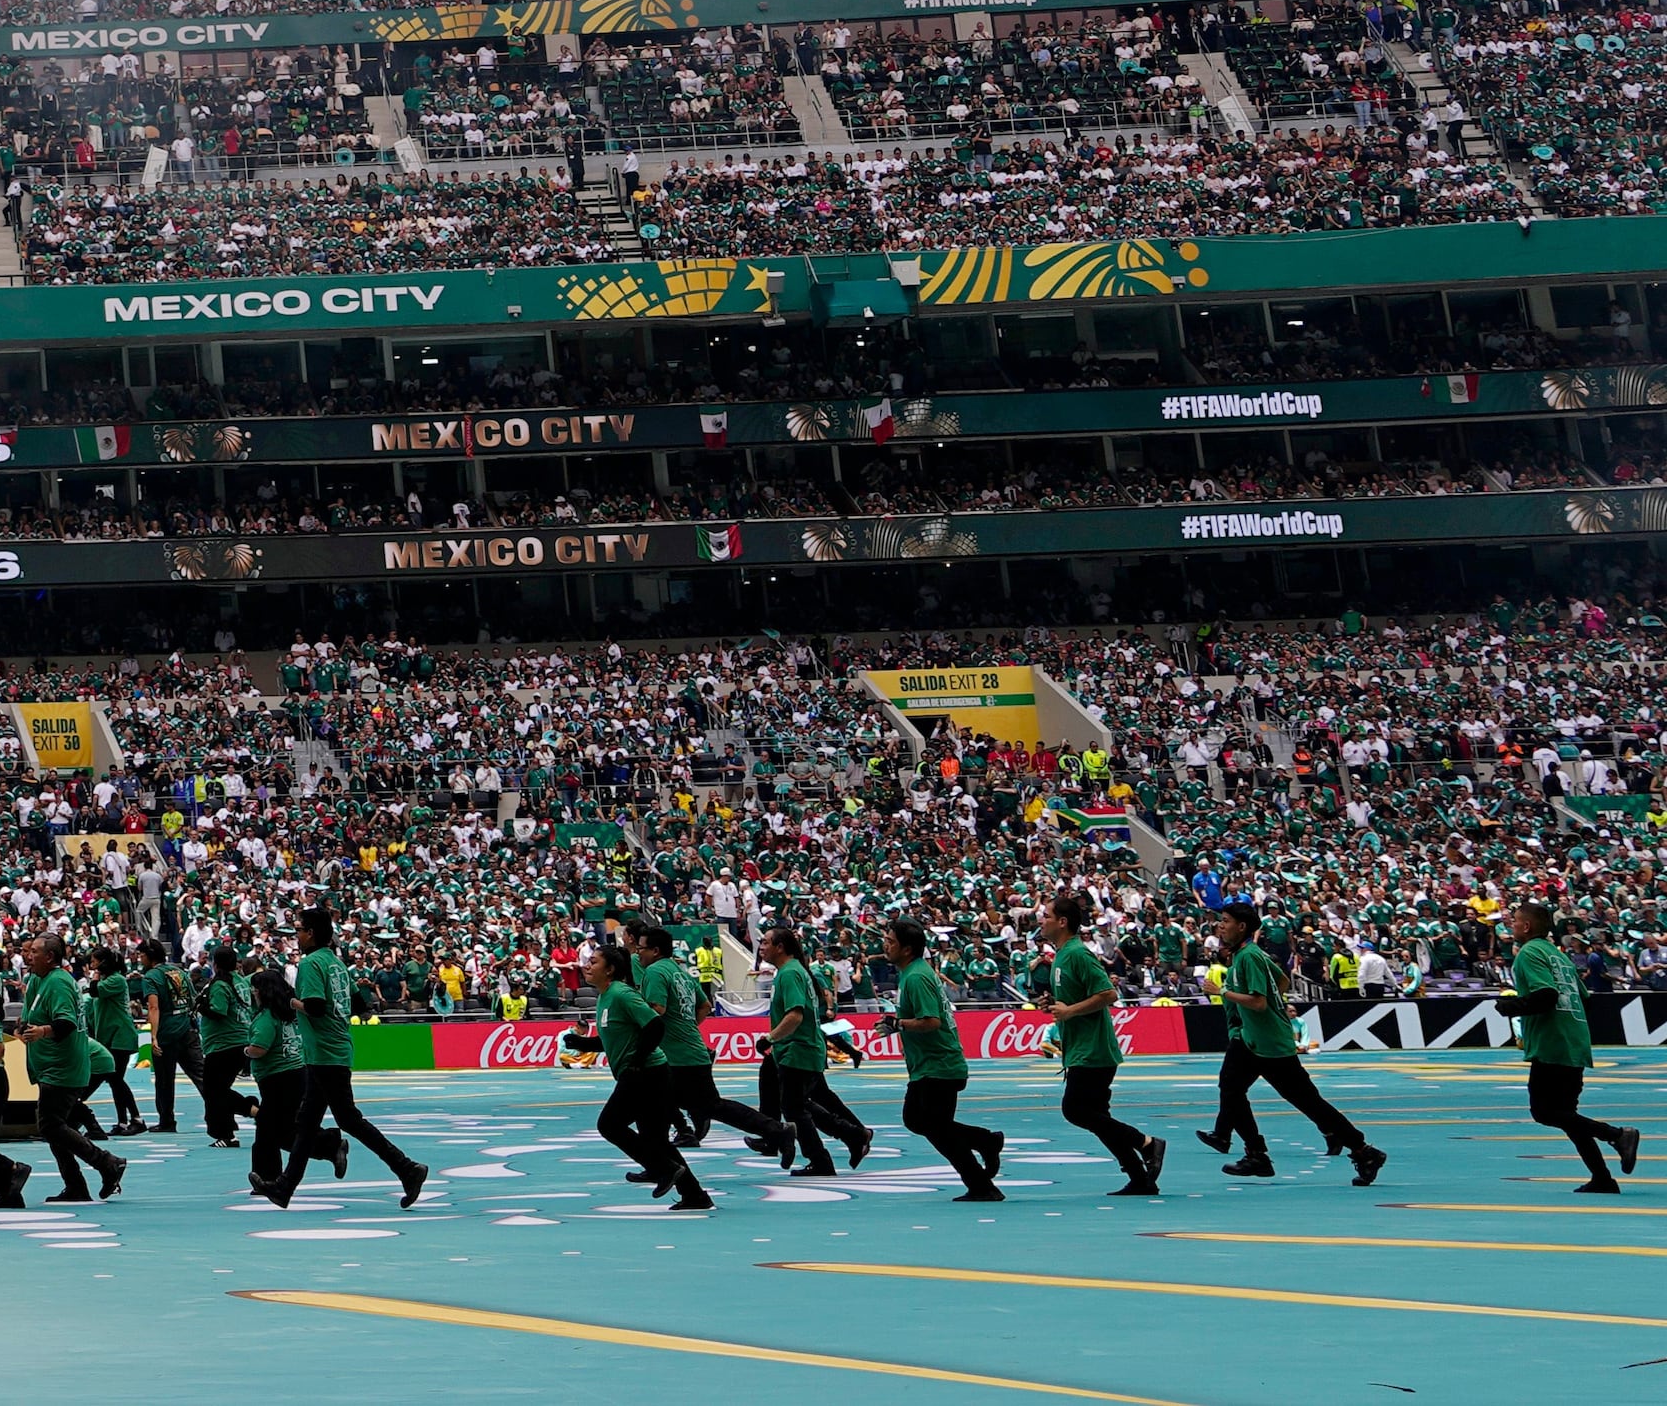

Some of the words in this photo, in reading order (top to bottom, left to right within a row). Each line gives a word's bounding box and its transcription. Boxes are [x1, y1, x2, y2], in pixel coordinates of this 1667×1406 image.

[12, 27, 168, 50] MEXICO
[176, 23, 269, 44] CITY
[104, 290, 311, 323] MEXICO
[321, 285, 445, 314] CITY
[1161, 392, 1323, 420] #FIFAWorldCup
[541, 414, 635, 445] CITY
[1180, 511, 1343, 539] #FIFAWorldCup
[384, 536, 544, 570] MEXICO
[554, 533, 650, 563] CITY
[900, 675, 948, 692] SALIDA
[949, 674, 977, 690] EXIT
[982, 673, 999, 689] 28
[33, 719, 77, 733] SALIDA
[33, 735, 59, 751] EXIT
[64, 735, 80, 751] 30
[570, 837, 597, 847] FIFA
[1301, 1000, 1512, 1051] KIA
[709, 1032, 768, 1060] zer
